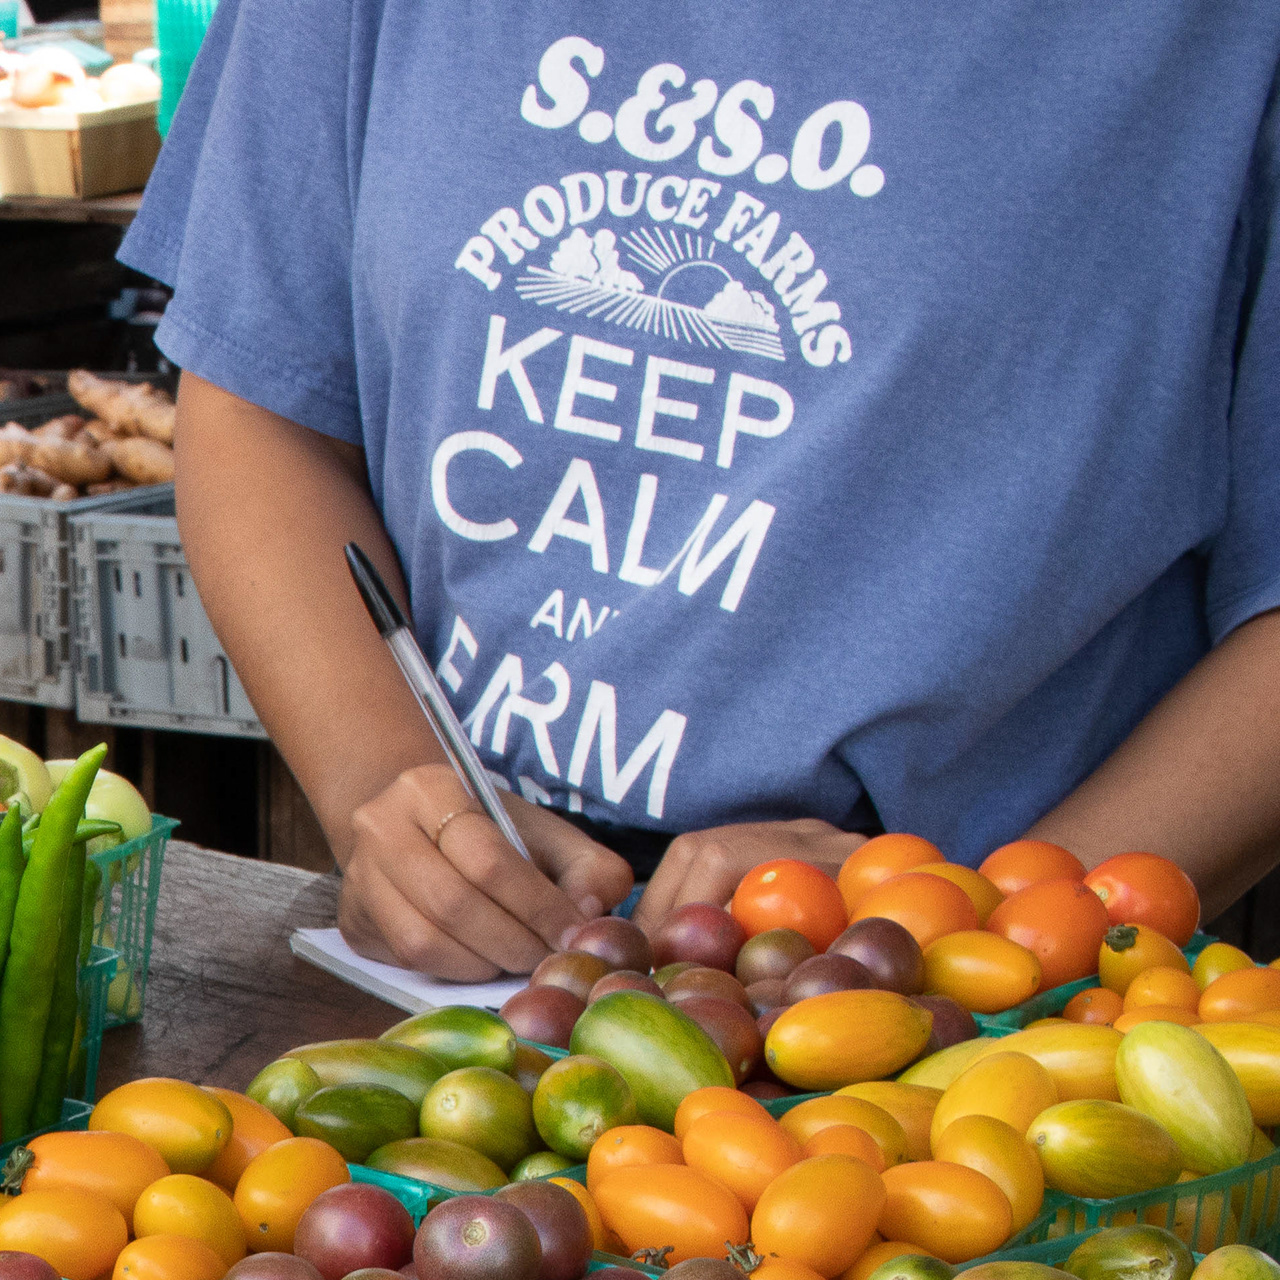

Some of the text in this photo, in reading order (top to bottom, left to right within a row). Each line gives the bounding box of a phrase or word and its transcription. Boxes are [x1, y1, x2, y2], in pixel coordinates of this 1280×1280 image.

[520, 36, 886, 198] S.&S.O.
[454, 170, 852, 368] PRODUCE FARMS
[476, 314, 795, 469] KEEP
